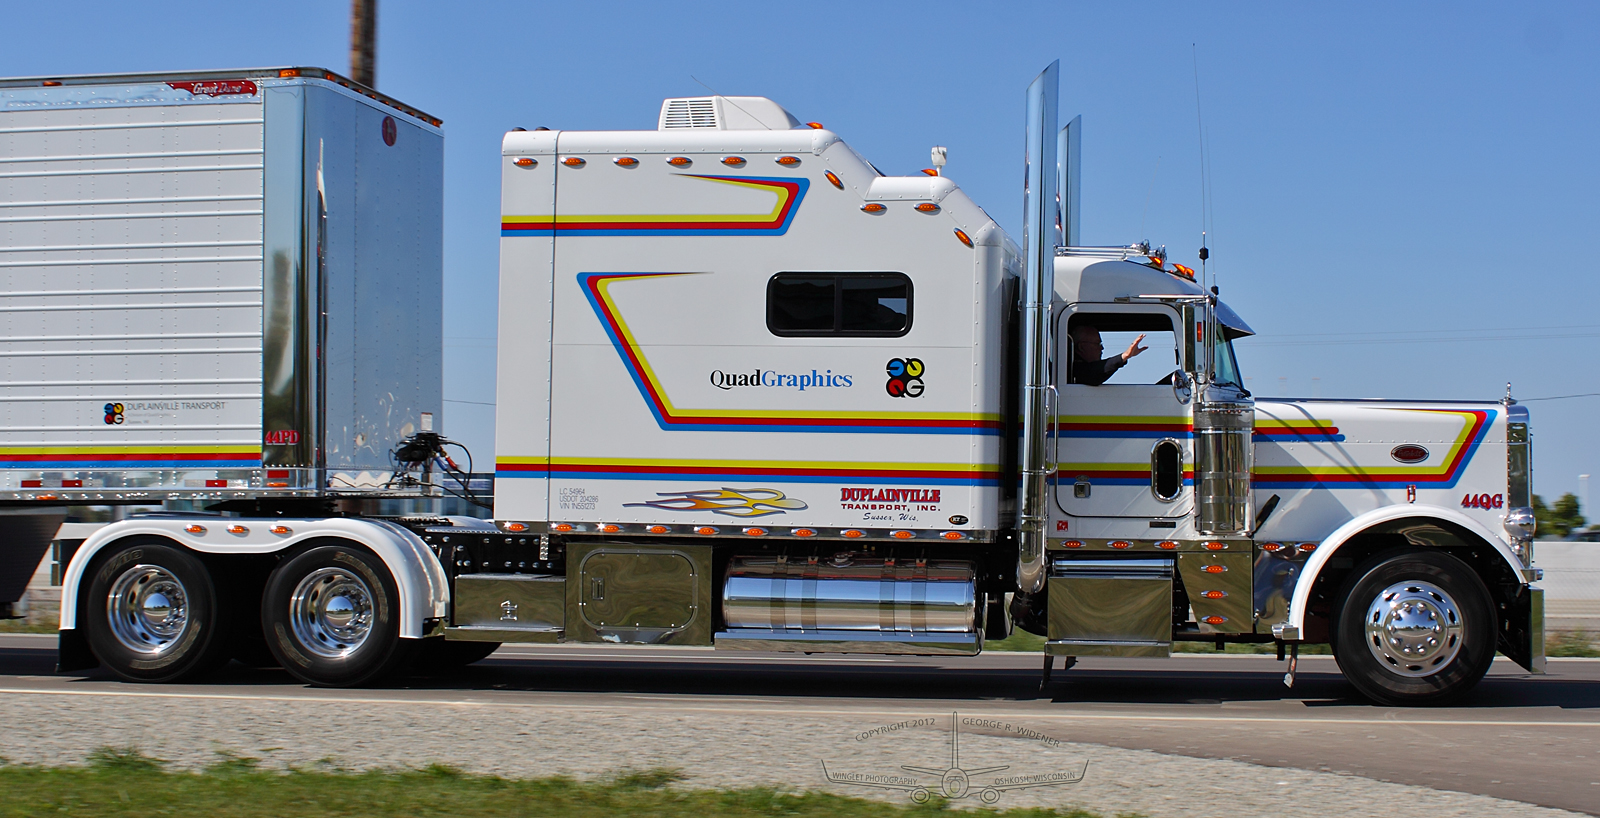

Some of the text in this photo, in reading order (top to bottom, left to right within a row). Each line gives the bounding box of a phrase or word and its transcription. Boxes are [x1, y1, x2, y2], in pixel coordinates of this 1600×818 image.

[193, 82, 241, 94] Great Dane
[710, 369, 853, 391] QuadGraphics
[127, 401, 225, 410] DUPLAINVILLE TRANSPORT
[265, 430, 300, 445] 44PD
[559, 487, 568, 495] LC
[840, 488, 941, 503] DUPLAINVILLE
[559, 495, 578, 503] USDOT
[1460, 493, 1504, 510] 44QG
[559, 502, 570, 510] VIN
[841, 503, 910, 512] TRANSPORT,
[898, 513, 919, 522] Wis.
